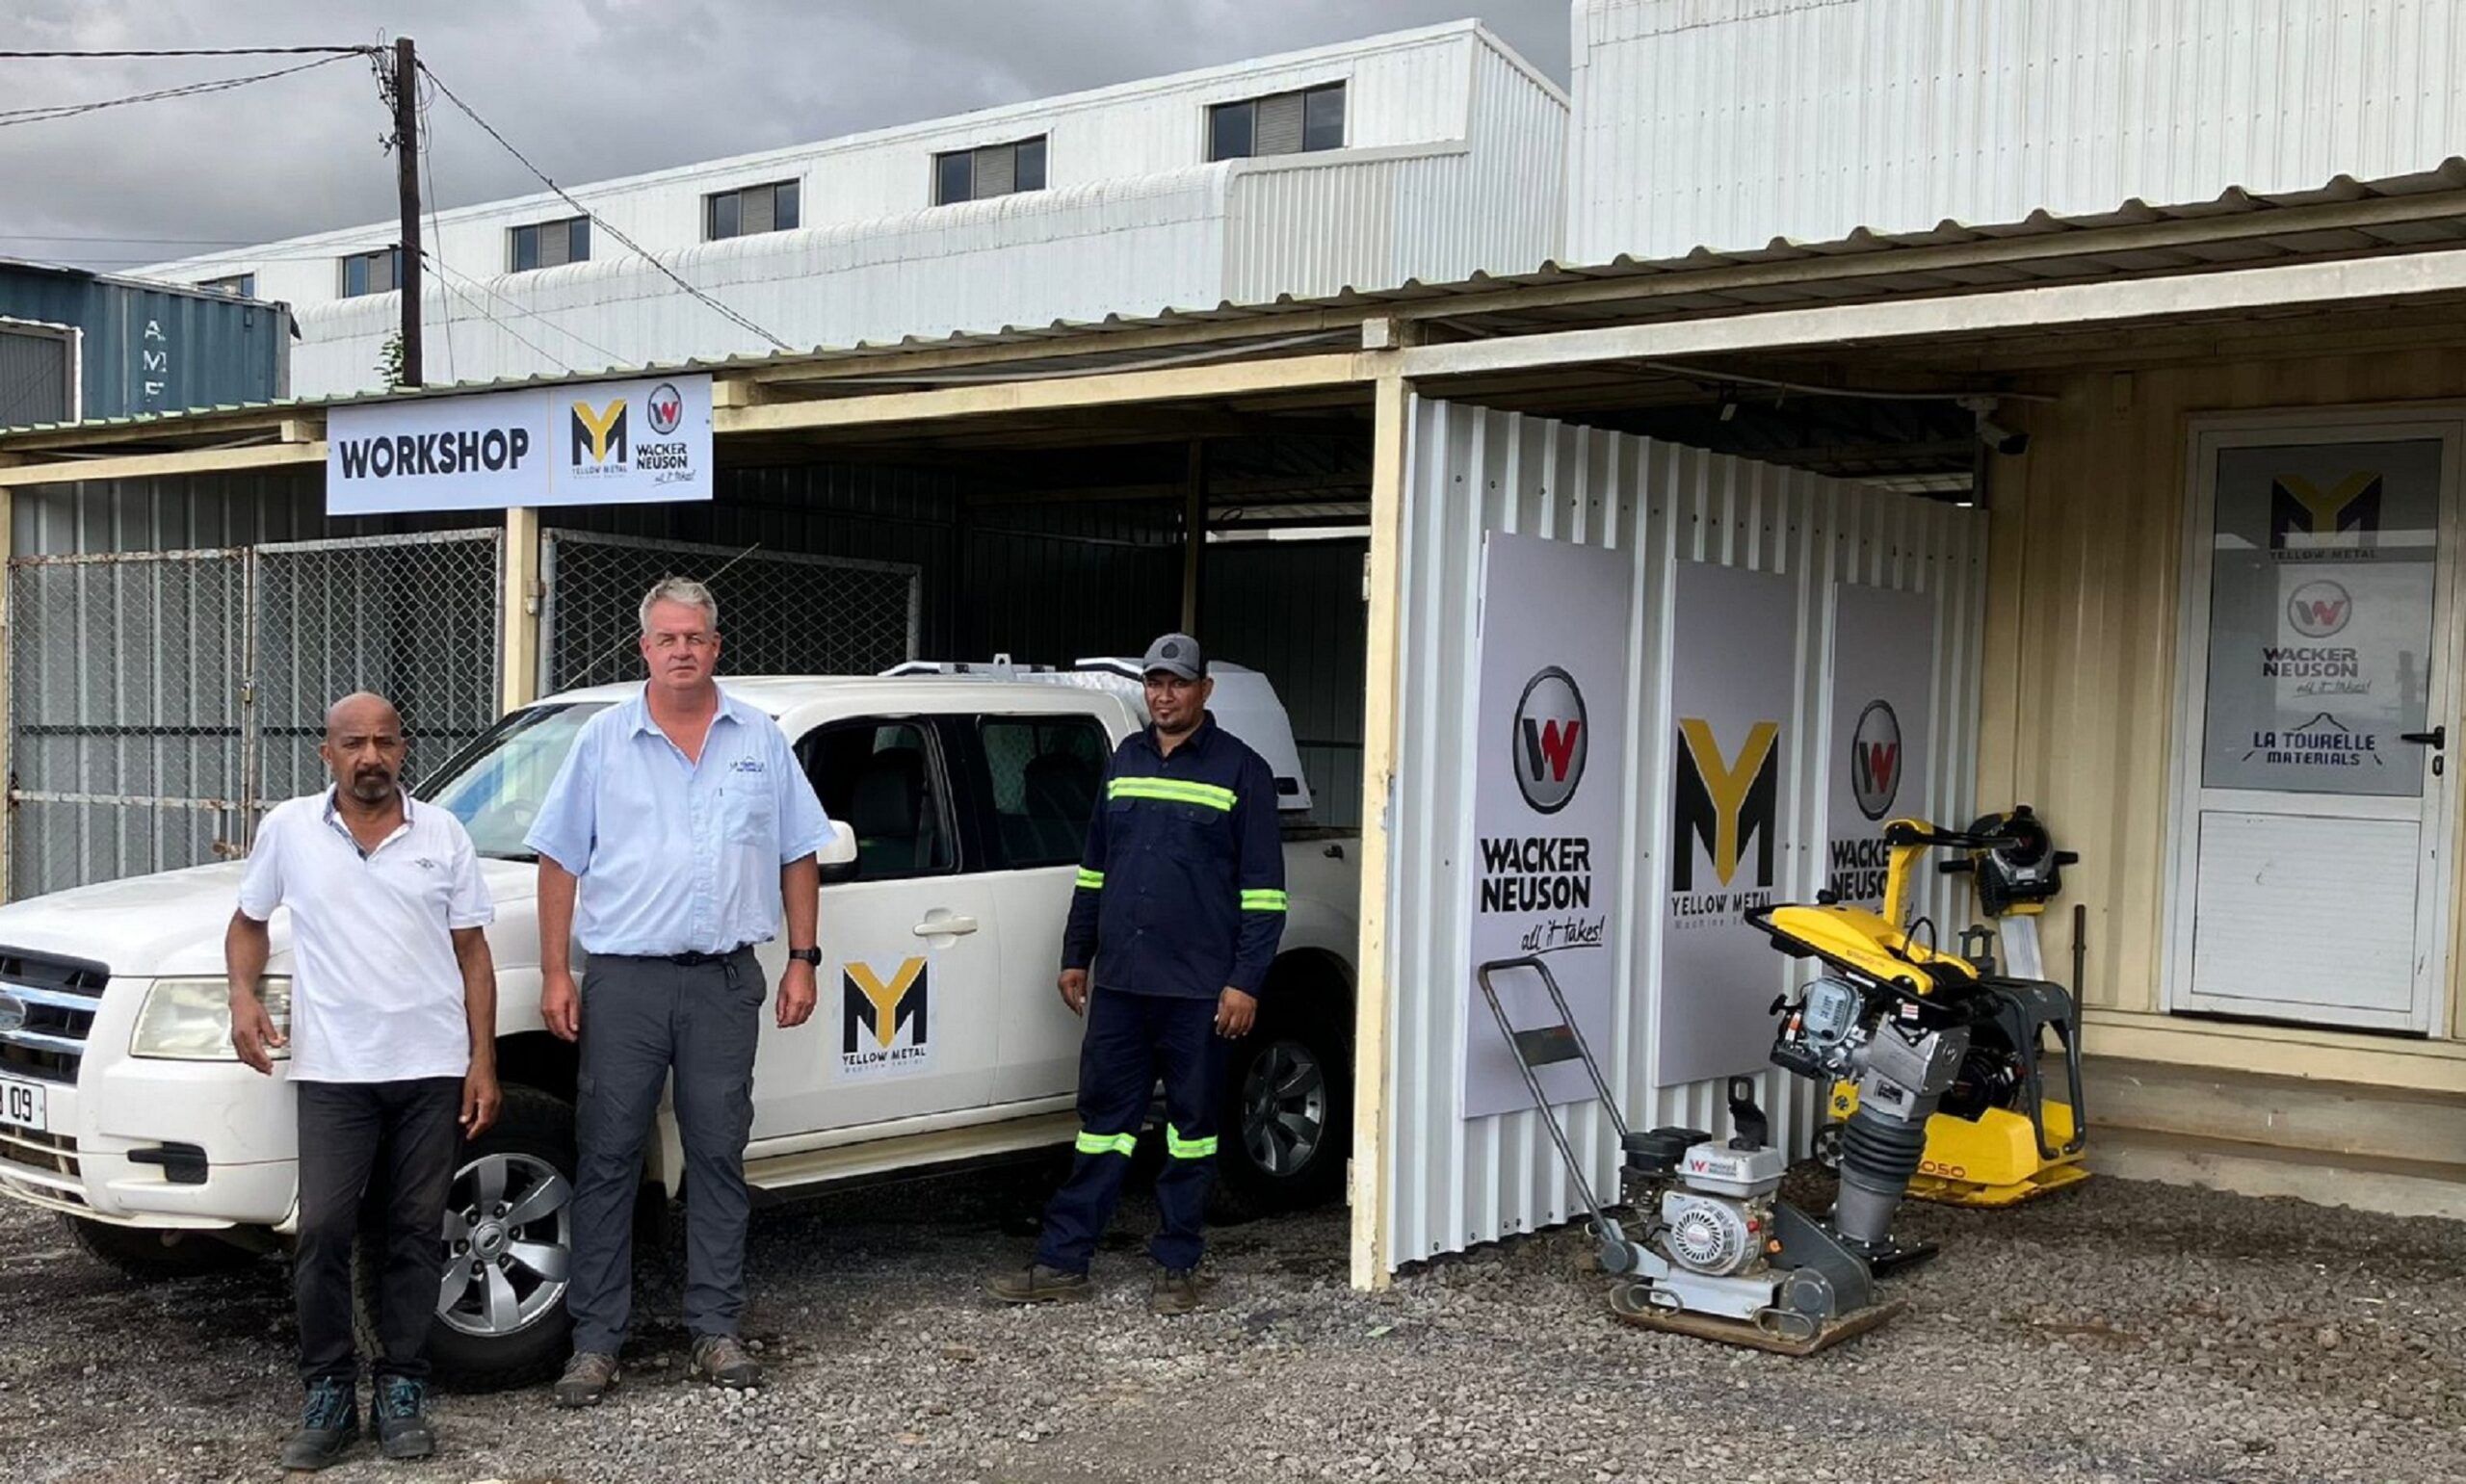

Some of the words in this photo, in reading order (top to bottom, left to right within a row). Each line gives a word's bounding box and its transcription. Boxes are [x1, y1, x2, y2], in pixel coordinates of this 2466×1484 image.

[339, 427, 529, 480] WORKSHOP
[636, 442, 687, 456] WACKER
[637, 456, 688, 470] NEUSON
[2269, 548, 2325, 560] YELLOW
[2332, 548, 2376, 560] METAL
[2262, 647, 2358, 662] WACKER
[2263, 663, 2358, 677] NEUSON
[2253, 732, 2275, 748] LA
[2282, 733, 2375, 751] TOURELLE
[2267, 751, 2361, 766] MATERIALS
[1480, 837, 1591, 874] WACKER
[1831, 839, 1890, 870] WACKE
[1481, 875, 1591, 913] NEUSON
[1831, 871, 1888, 901] NEUSO
[1672, 895, 1727, 917] YELLOW
[1521, 924, 1542, 950] all
[1547, 919, 1563, 948] it
[1564, 915, 1606, 945] takes!
[842, 1051, 887, 1066] YELLOW
[891, 1047, 927, 1060] METAL
